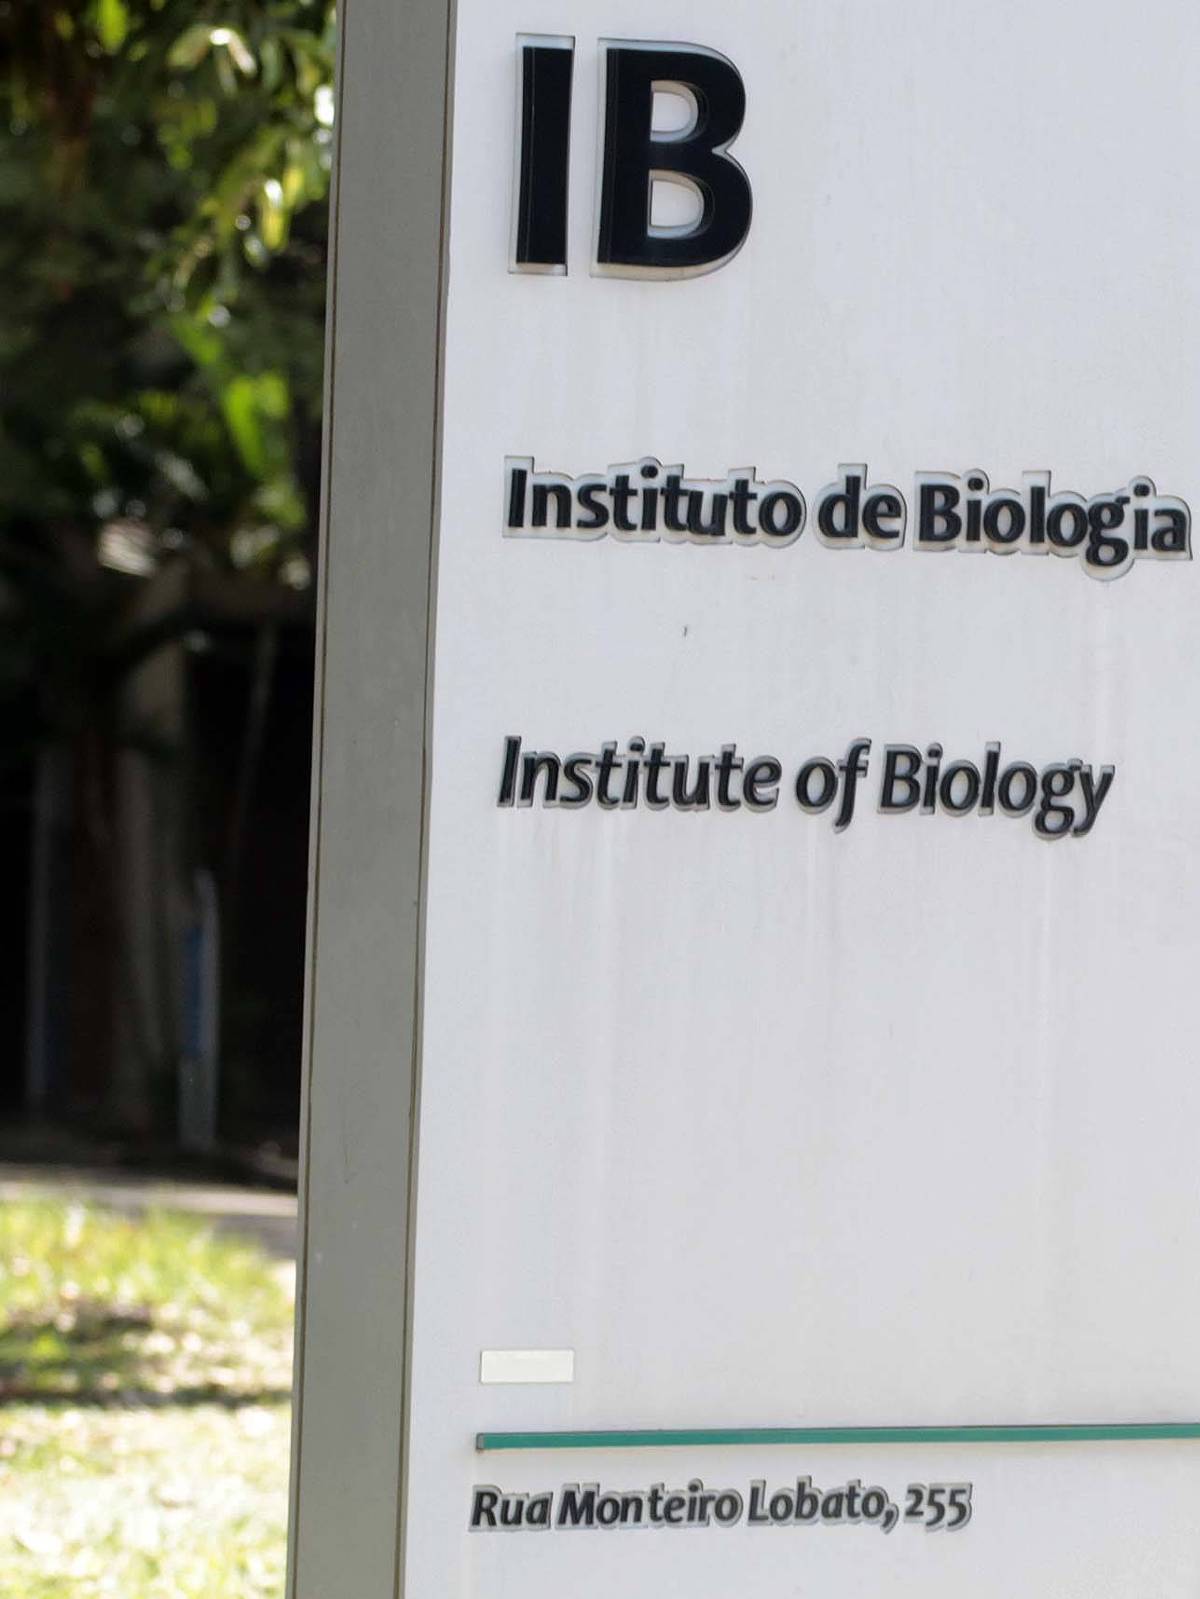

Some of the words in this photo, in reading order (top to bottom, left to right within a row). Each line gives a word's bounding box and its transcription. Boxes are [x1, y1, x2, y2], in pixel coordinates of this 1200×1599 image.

[509, 34, 752, 280] IB
[504, 457, 804, 546] Instituto
[814, 465, 906, 548] de
[914, 470, 1191, 578] Biologia
[498, 736, 781, 811] Institute
[796, 738, 870, 833] of
[878, 742, 1115, 839] Biology
[469, 1485, 553, 1531] Rua
[556, 1479, 741, 1529] Monteiro
[747, 1476, 899, 1532] Lobato,
[904, 1482, 973, 1532] 255
